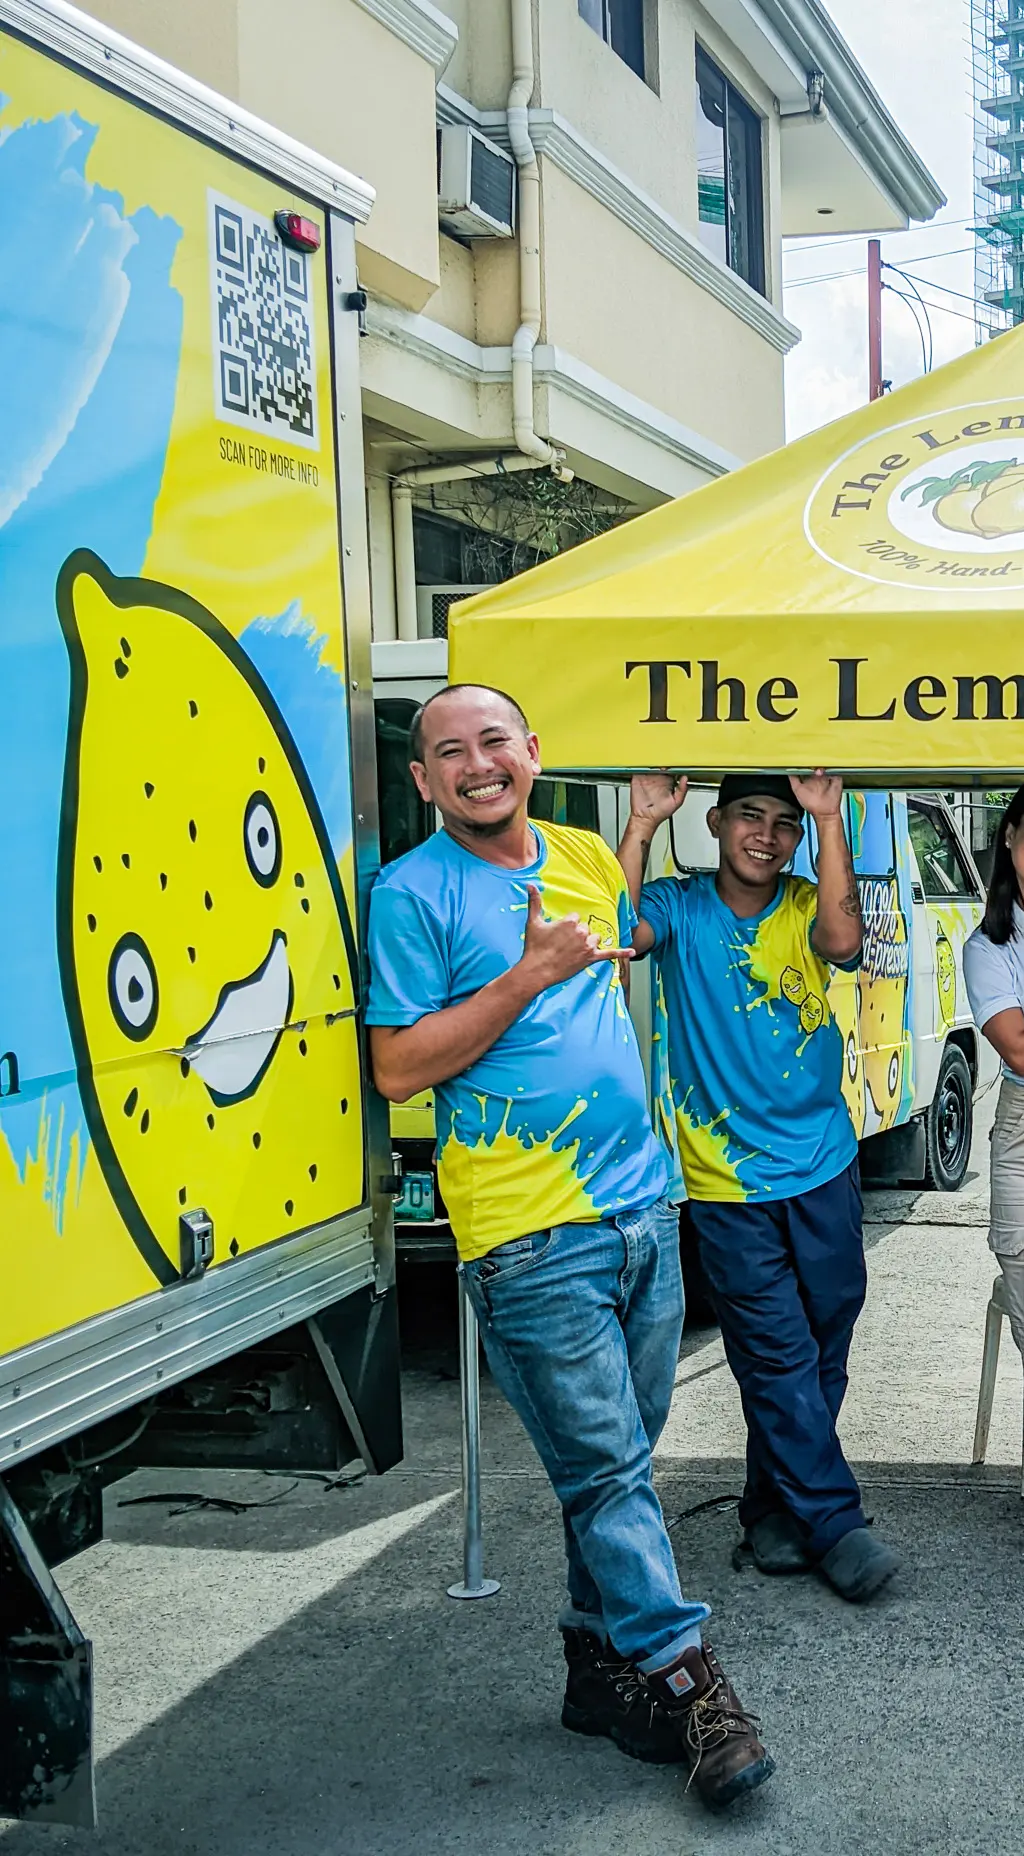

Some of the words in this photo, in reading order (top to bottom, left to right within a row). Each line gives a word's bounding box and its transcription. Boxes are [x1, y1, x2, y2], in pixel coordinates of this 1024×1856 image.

[219, 436, 246, 467] SCAN
[248, 445, 268, 473] FOR
[270, 452, 296, 481] MORE
[297, 460, 319, 488] INFO
[830, 453, 911, 518] The
[857, 538, 931, 571] 100%
[625, 659, 799, 723] The
